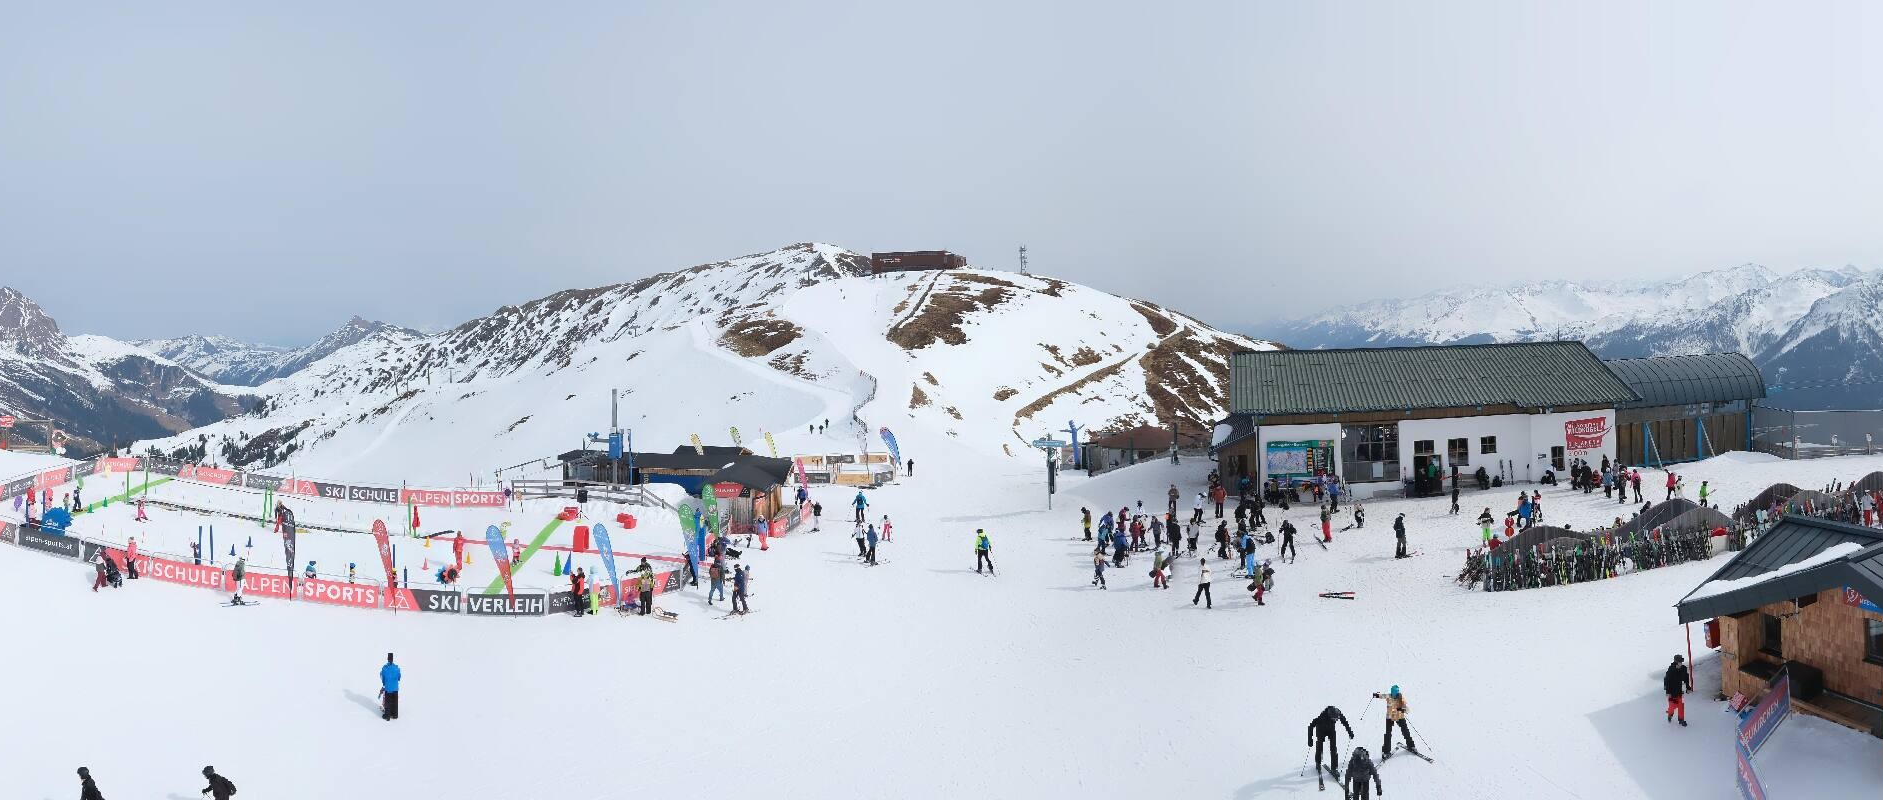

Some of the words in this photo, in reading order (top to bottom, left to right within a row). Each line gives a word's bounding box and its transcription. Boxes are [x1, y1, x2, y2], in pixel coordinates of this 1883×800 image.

[326, 486, 346, 498] SKI
[351, 489, 397, 502] SCHULE
[410, 491, 450, 504] ALPEN
[454, 492, 503, 504] SPORTS
[25, 535, 73, 551] alpen-sports.at
[153, 561, 219, 586] SCHULE
[241, 576, 294, 595] ALPEN
[305, 581, 375, 604] SPORTS
[428, 594, 459, 611] SKI
[469, 597, 543, 613] VERLEIH
